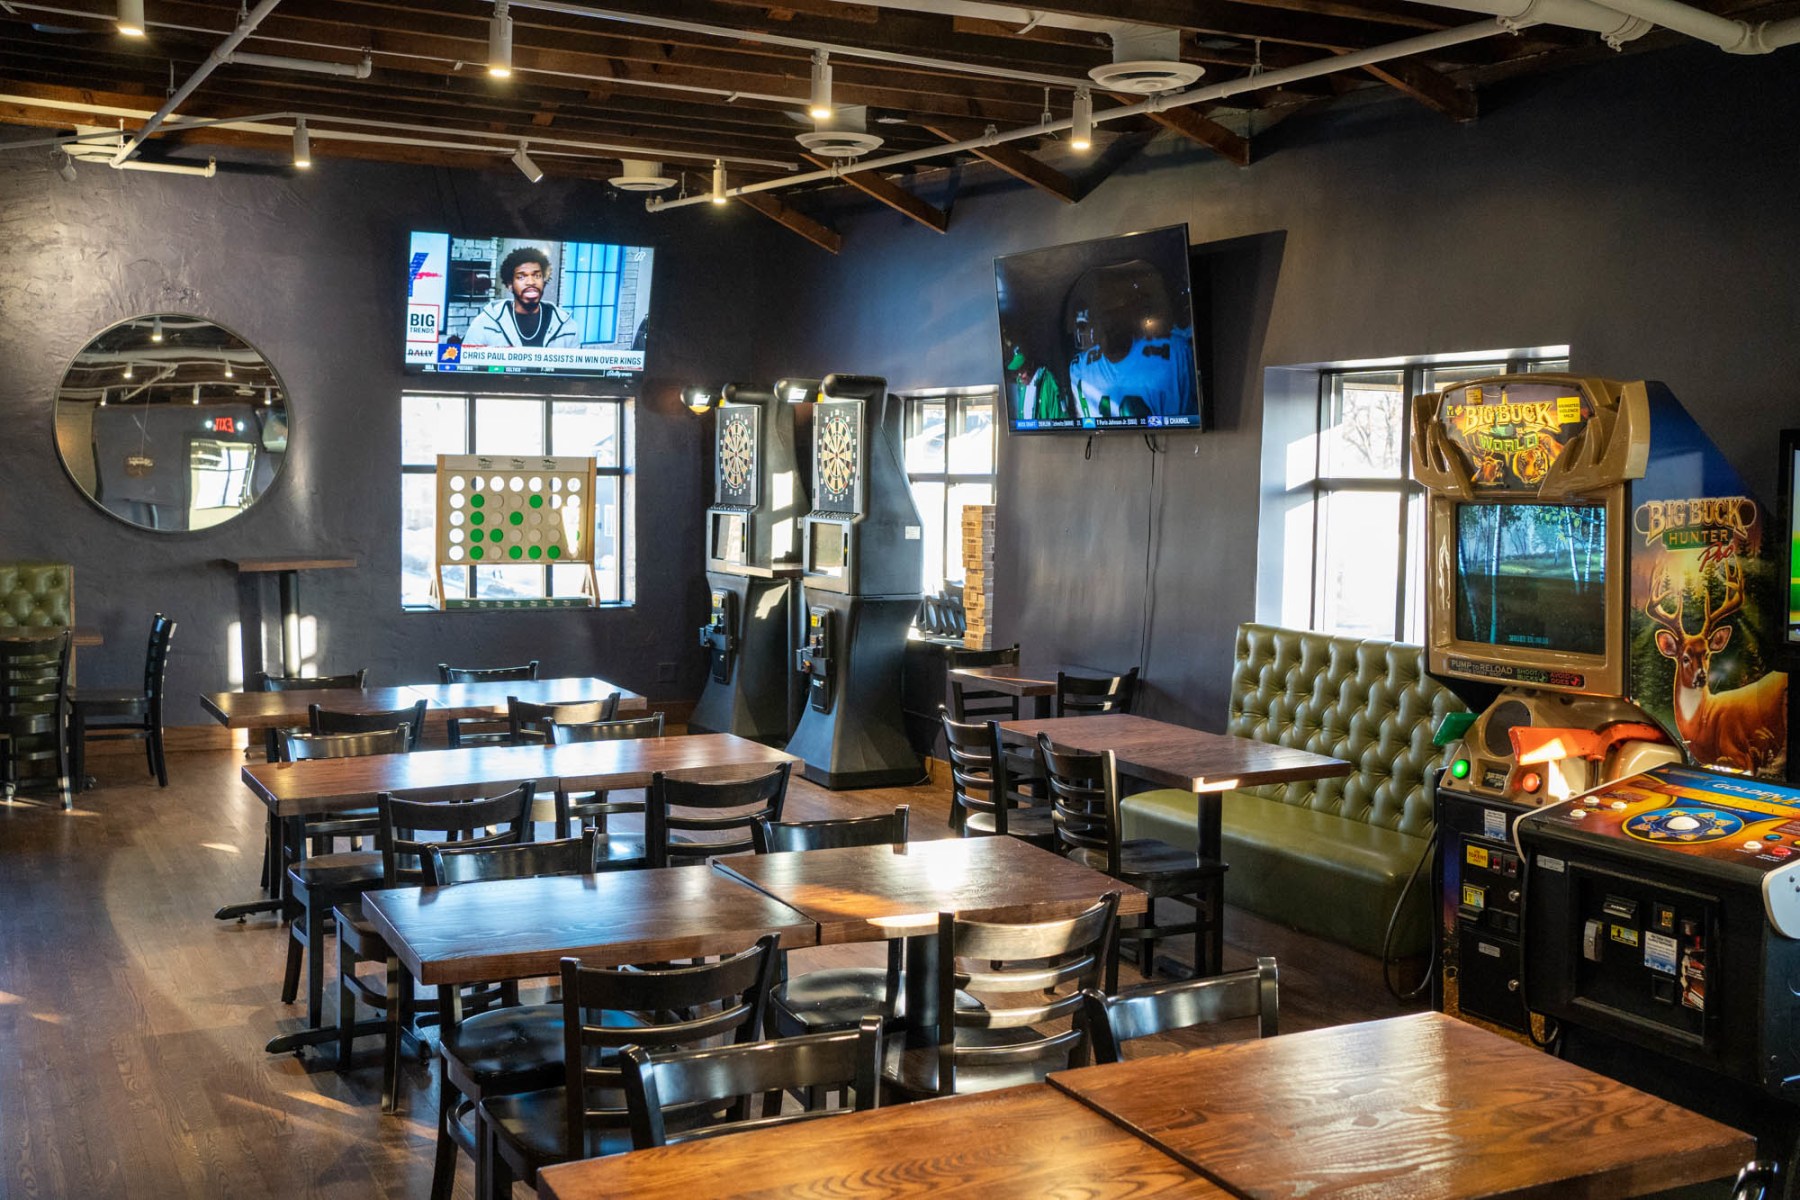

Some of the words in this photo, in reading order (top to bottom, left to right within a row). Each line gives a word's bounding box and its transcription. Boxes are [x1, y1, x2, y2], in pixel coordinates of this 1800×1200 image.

[410, 313, 435, 327] BIG
[407, 349, 434, 357] RALLY
[462, 351, 485, 360] CHRIS
[487, 352, 506, 361] PAUL
[508, 353, 533, 362] DROPS
[544, 354, 574, 363] ASSISTS
[575, 355, 583, 363] IN
[584, 356, 598, 364] WIN
[600, 356, 618, 365] OVER
[620, 357, 642, 366] KINGS
[1462, 405, 1496, 437] BIG
[1497, 402, 1562, 434] BUCK
[1480, 432, 1541, 452] WORLD
[1646, 500, 1687, 545] BIG
[1688, 497, 1748, 538] BUCK
[1668, 529, 1730, 545] HUNTER
[1697, 541, 1736, 572] Pro
[1451, 659, 1473, 669] PUMP
[1480, 663, 1513, 675] RELOAD
[1712, 783, 1787, 801] GOLDEN
